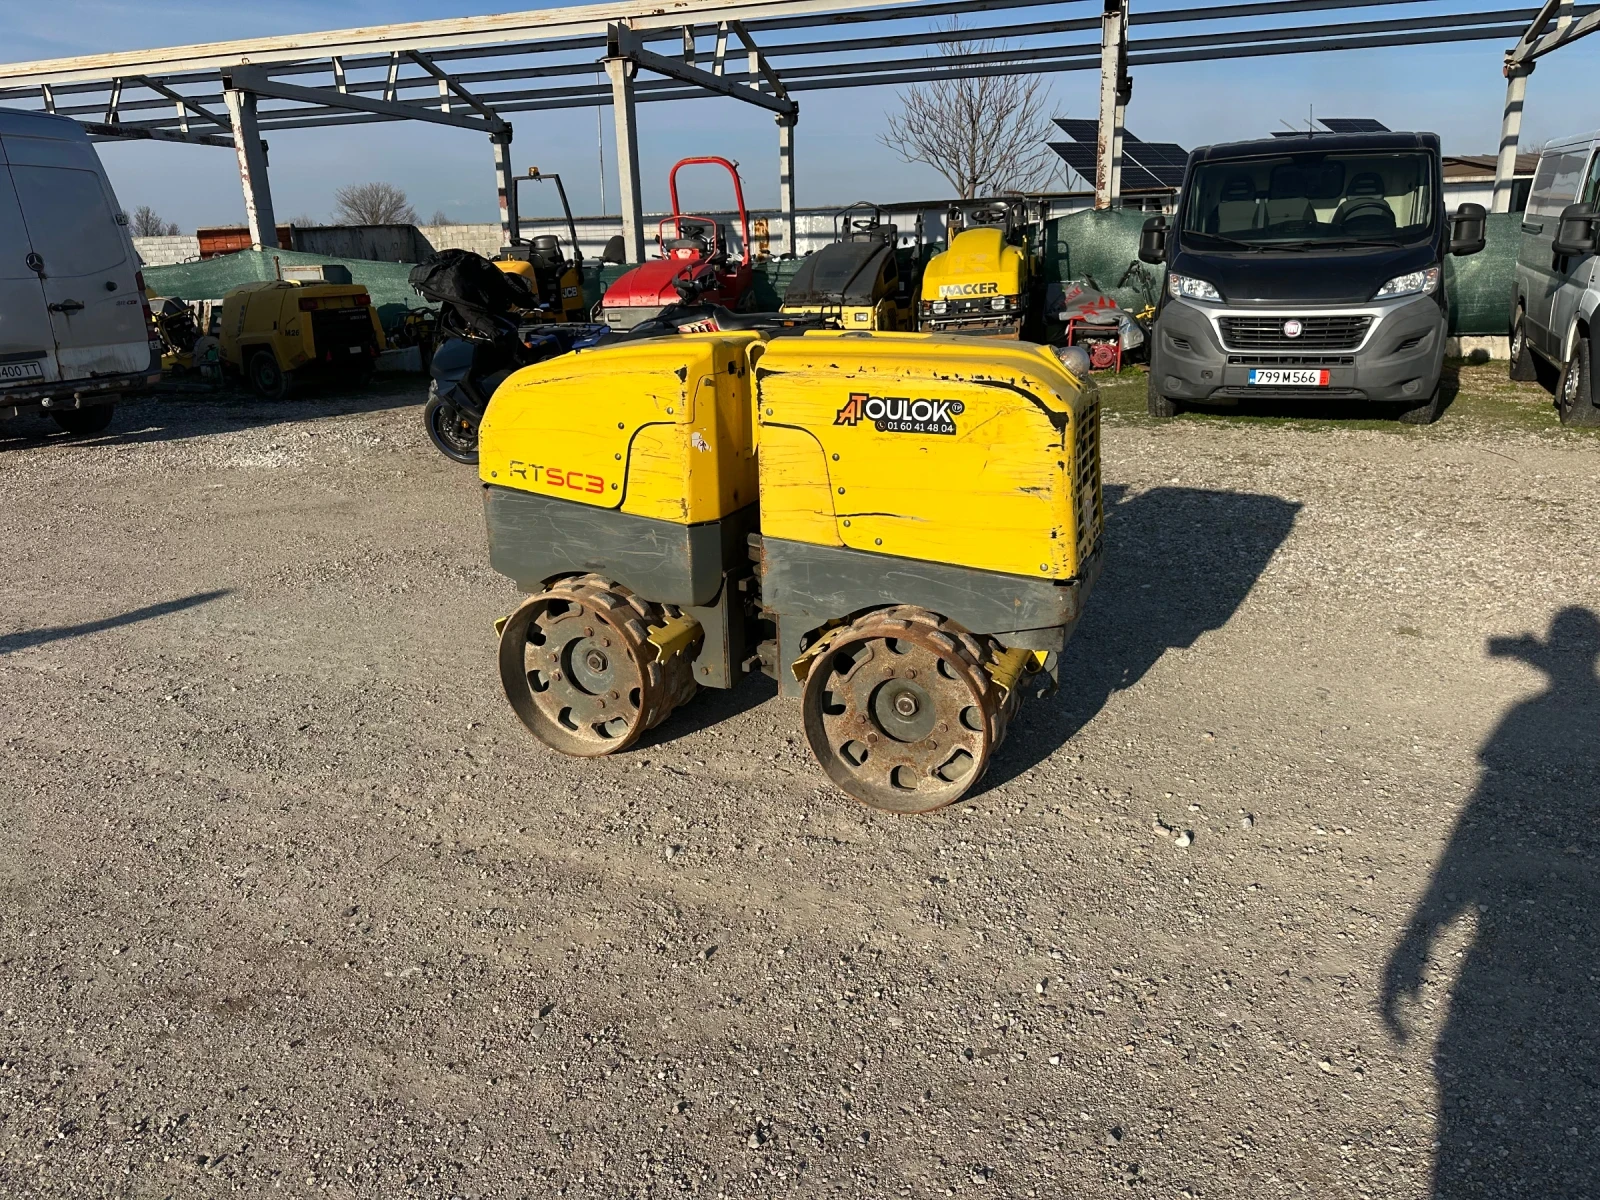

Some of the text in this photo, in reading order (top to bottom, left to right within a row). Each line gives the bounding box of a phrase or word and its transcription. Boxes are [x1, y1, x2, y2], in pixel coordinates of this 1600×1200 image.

[562, 287, 578, 298] JCB
[940, 282, 999, 296] WACKER
[284, 329, 300, 337] M26
[1257, 371, 1280, 383] 799
[1292, 371, 1316, 383] 566
[887, 421, 954, 433] 01 60 41 48 04
